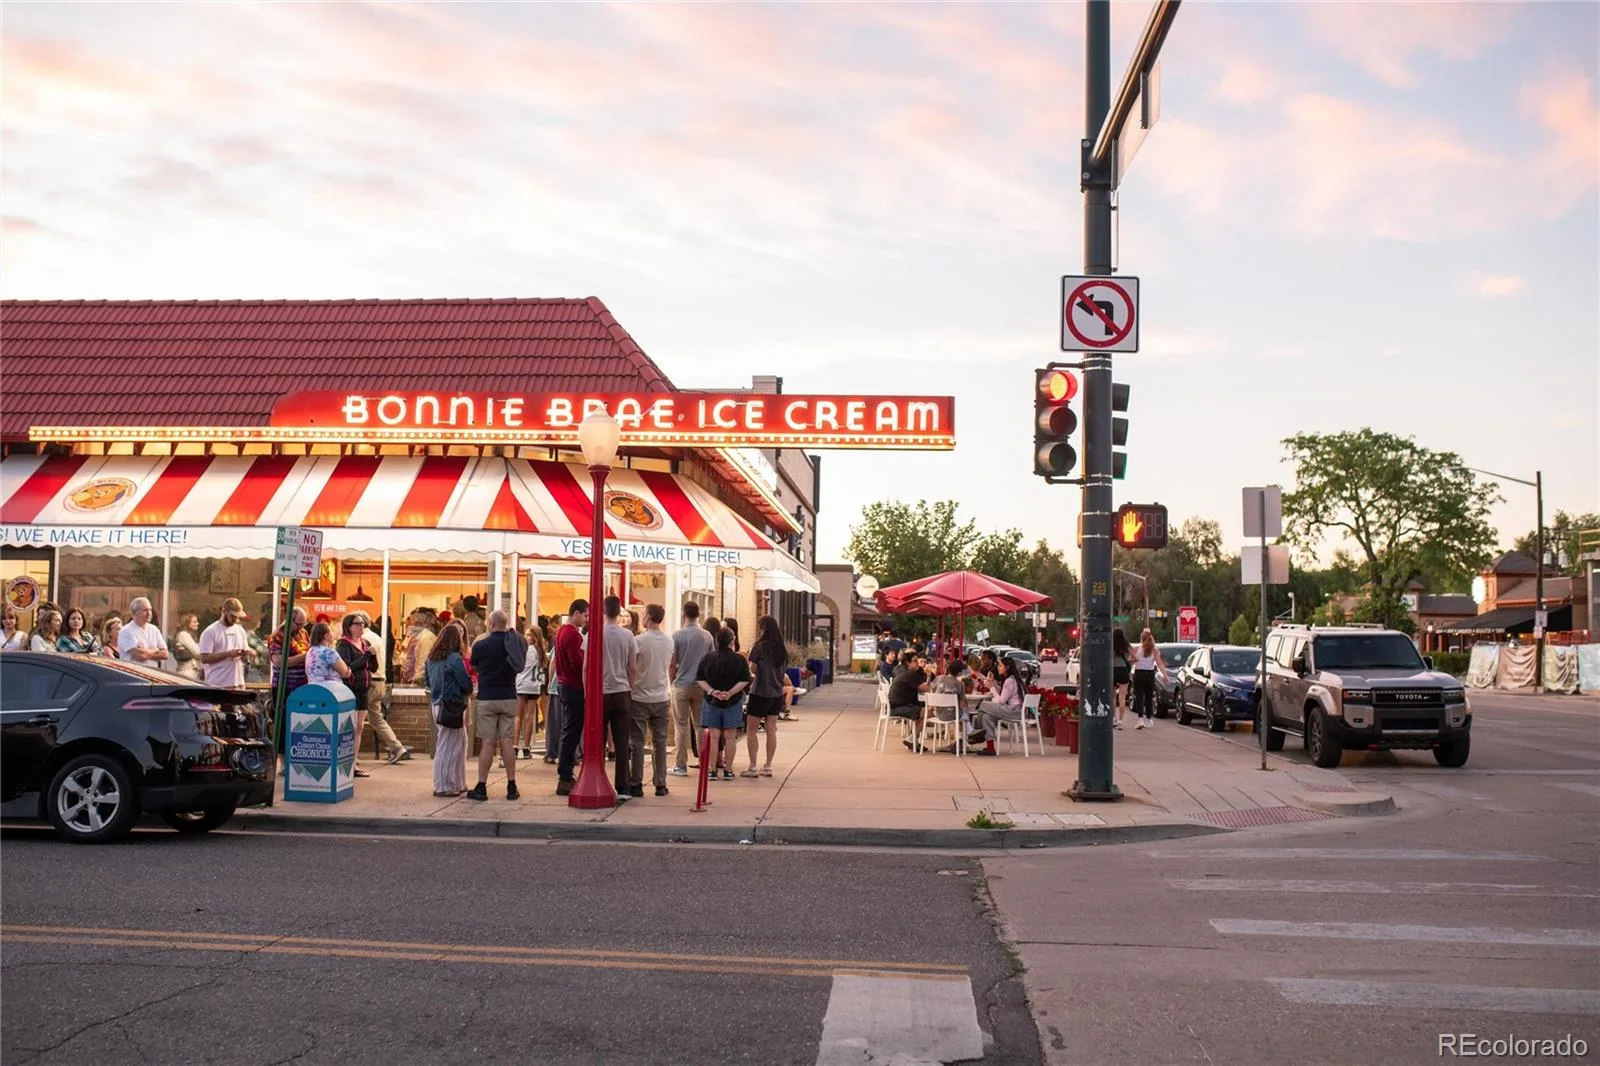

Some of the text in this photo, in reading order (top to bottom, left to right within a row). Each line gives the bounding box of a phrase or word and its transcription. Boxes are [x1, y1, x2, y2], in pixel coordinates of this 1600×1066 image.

[342, 396, 525, 428] BONNIE
[698, 400, 765, 429] ICE
[784, 401, 940, 431] CREAM
[15, 528, 44, 542] WE
[50, 529, 102, 543] MAKE
[108, 530, 125, 544] IT
[130, 530, 188, 544] HERE!
[303, 534, 317, 545] NO
[604, 542, 628, 557] WE
[633, 544, 676, 561] MAKE
[680, 548, 694, 562] IT
[697, 550, 741, 565] HERE!
[290, 745, 332, 759] CHRONICLE
